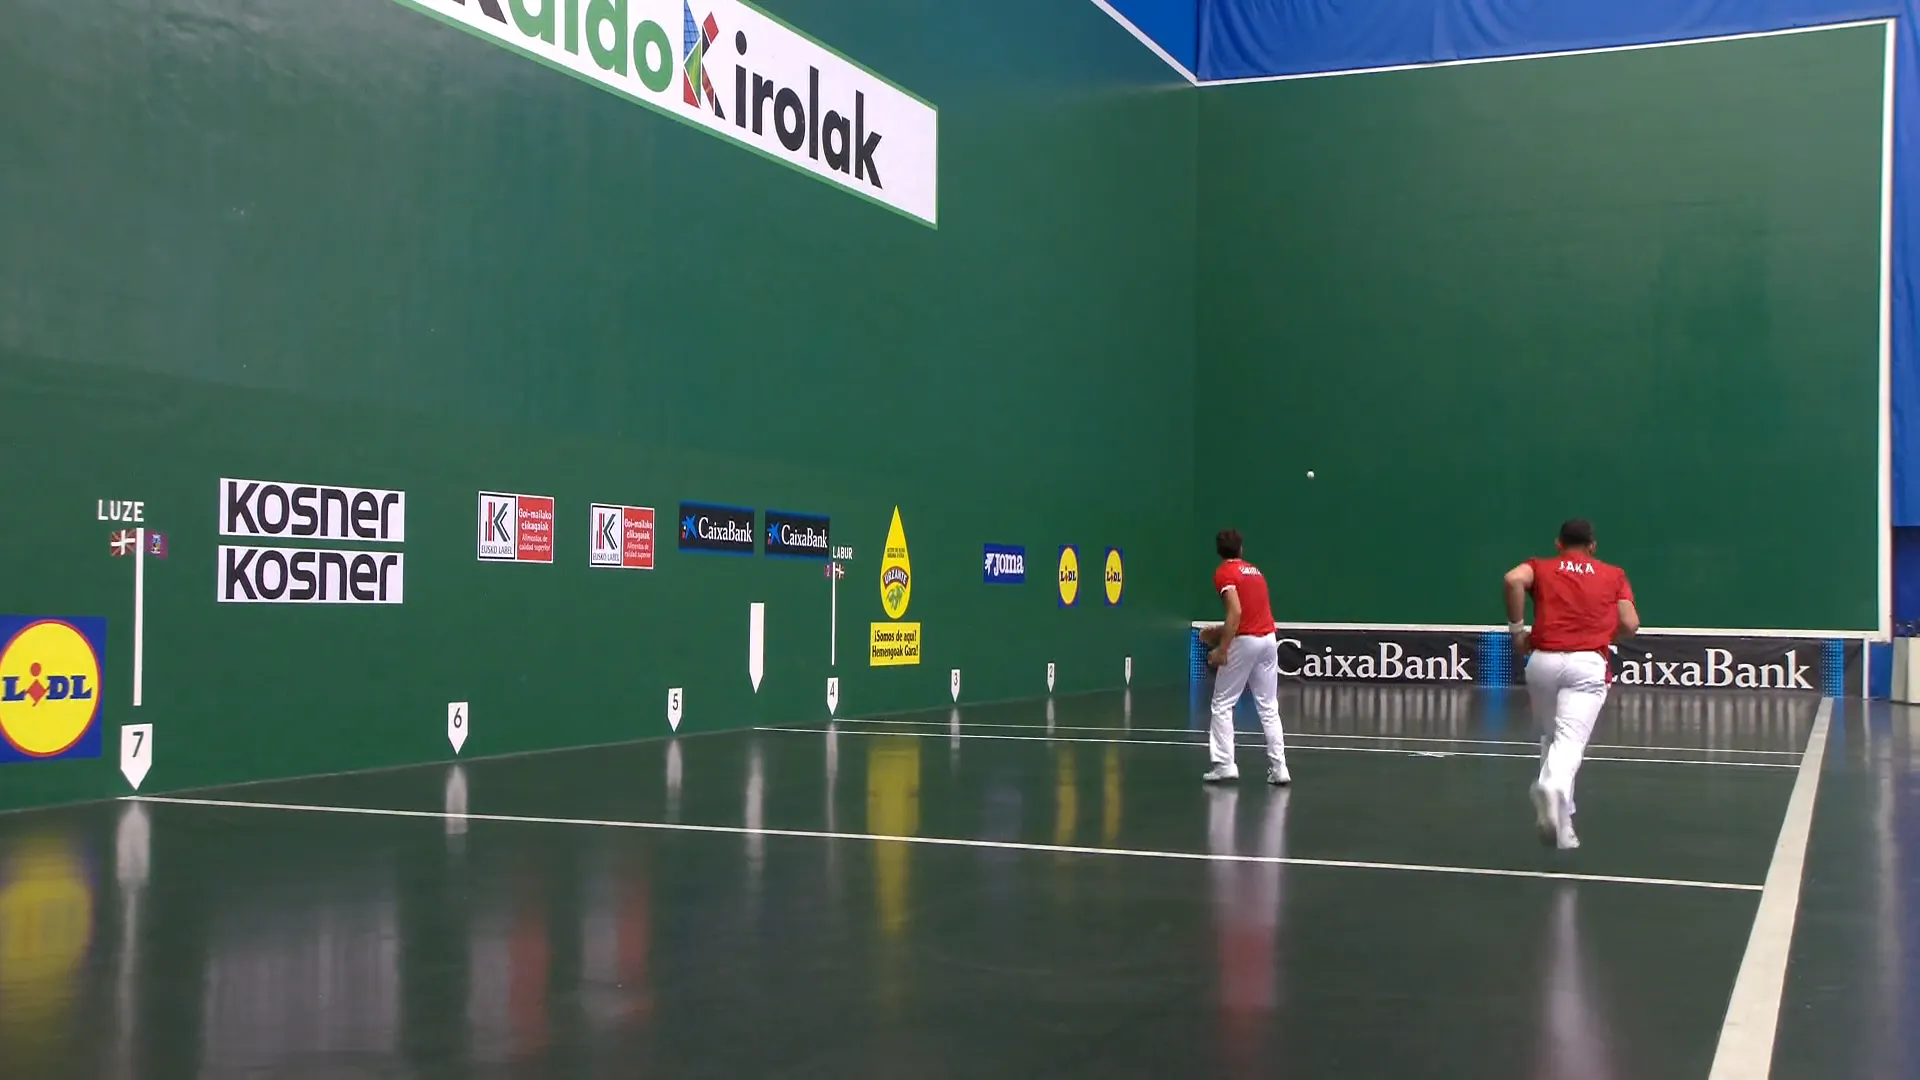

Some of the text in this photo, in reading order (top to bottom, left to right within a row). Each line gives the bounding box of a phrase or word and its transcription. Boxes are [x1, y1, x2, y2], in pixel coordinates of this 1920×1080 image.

[98, 499, 144, 522] LUZE
[698, 516, 753, 543] CaixaBank
[781, 524, 828, 548] CaixaBank
[481, 545, 513, 555] EUSKO LABEL
[832, 546, 853, 560] LABUR
[1558, 560, 1596, 575] JAKA
[896, 630, 903, 642] de
[1276, 638, 1473, 681] CaixaBank
[953, 672, 959, 686] 3
[829, 681, 835, 698] 4
[672, 693, 679, 711] 5
[453, 707, 462, 728] 6
[132, 731, 144, 758] 7
